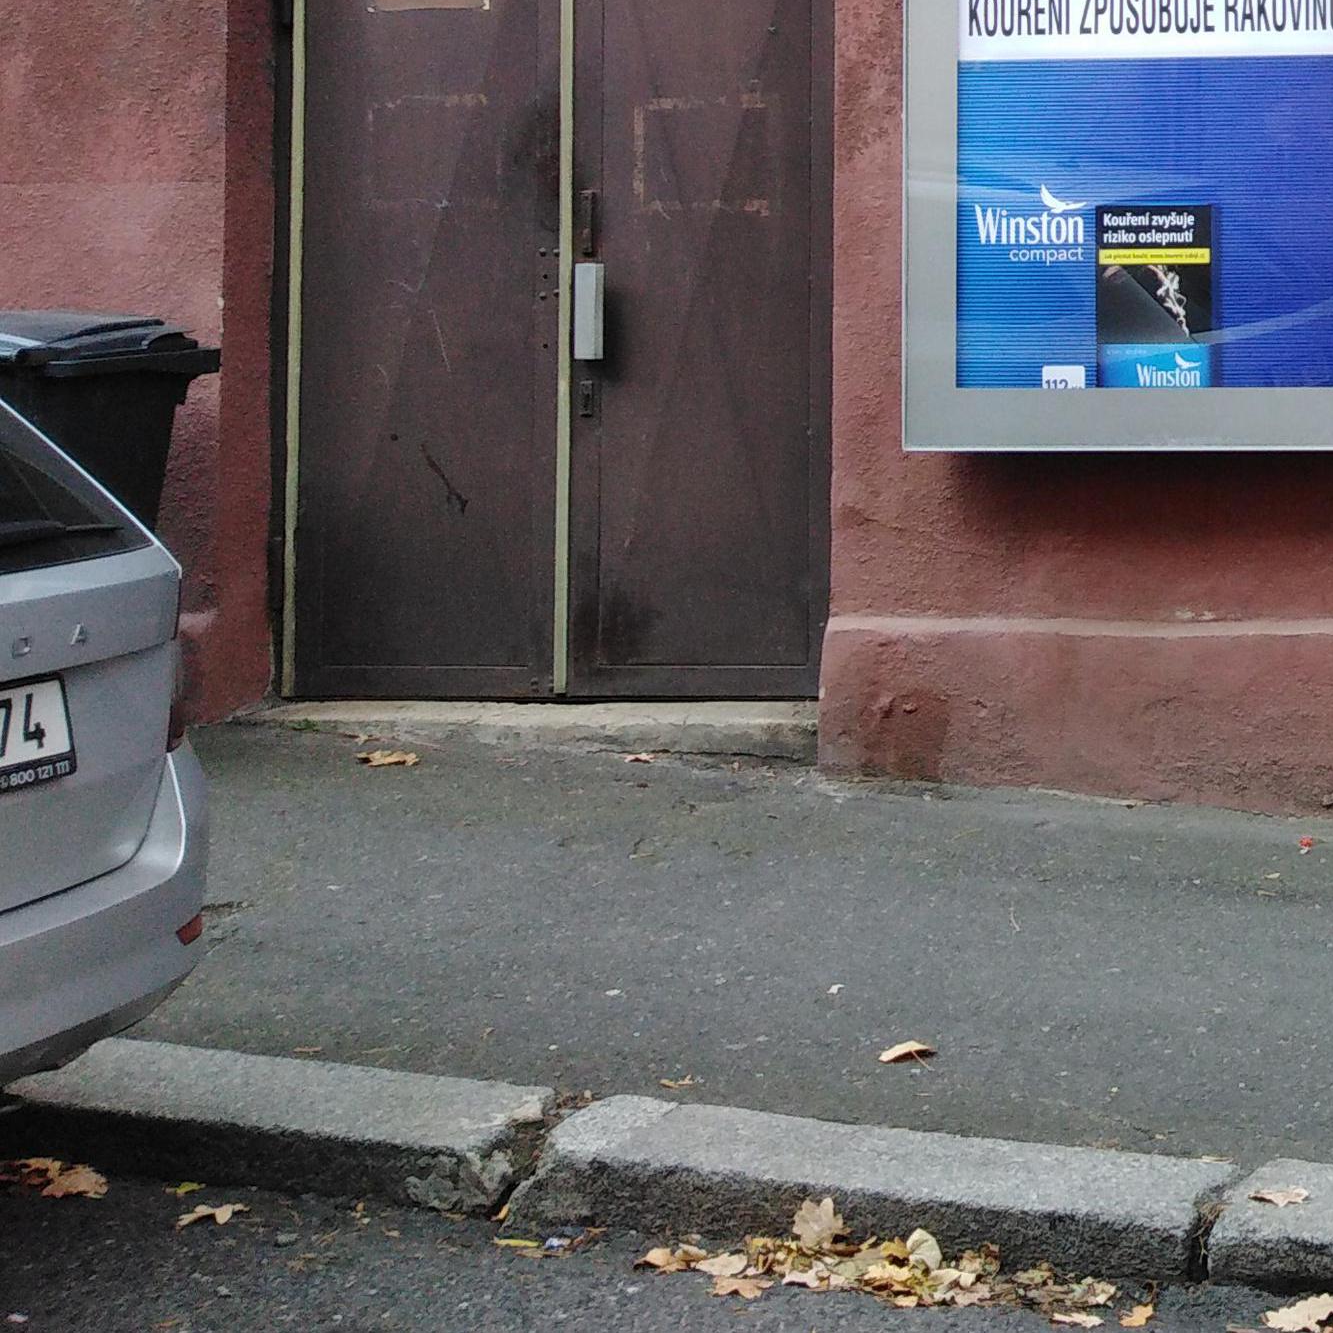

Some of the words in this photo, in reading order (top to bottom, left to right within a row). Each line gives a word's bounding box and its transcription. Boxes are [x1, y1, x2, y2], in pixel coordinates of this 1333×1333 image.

[975, 204, 1084, 245] Winston
[1103, 212, 1150, 226] Kouření
[1151, 212, 1194, 229] zvyšuje
[1103, 229, 1136, 243] riziko
[1138, 228, 1194, 246] oslepnutí
[1010, 246, 1084, 266] compact
[1136, 362, 1201, 388] Winston
[10, 769, 35, 786] 800
